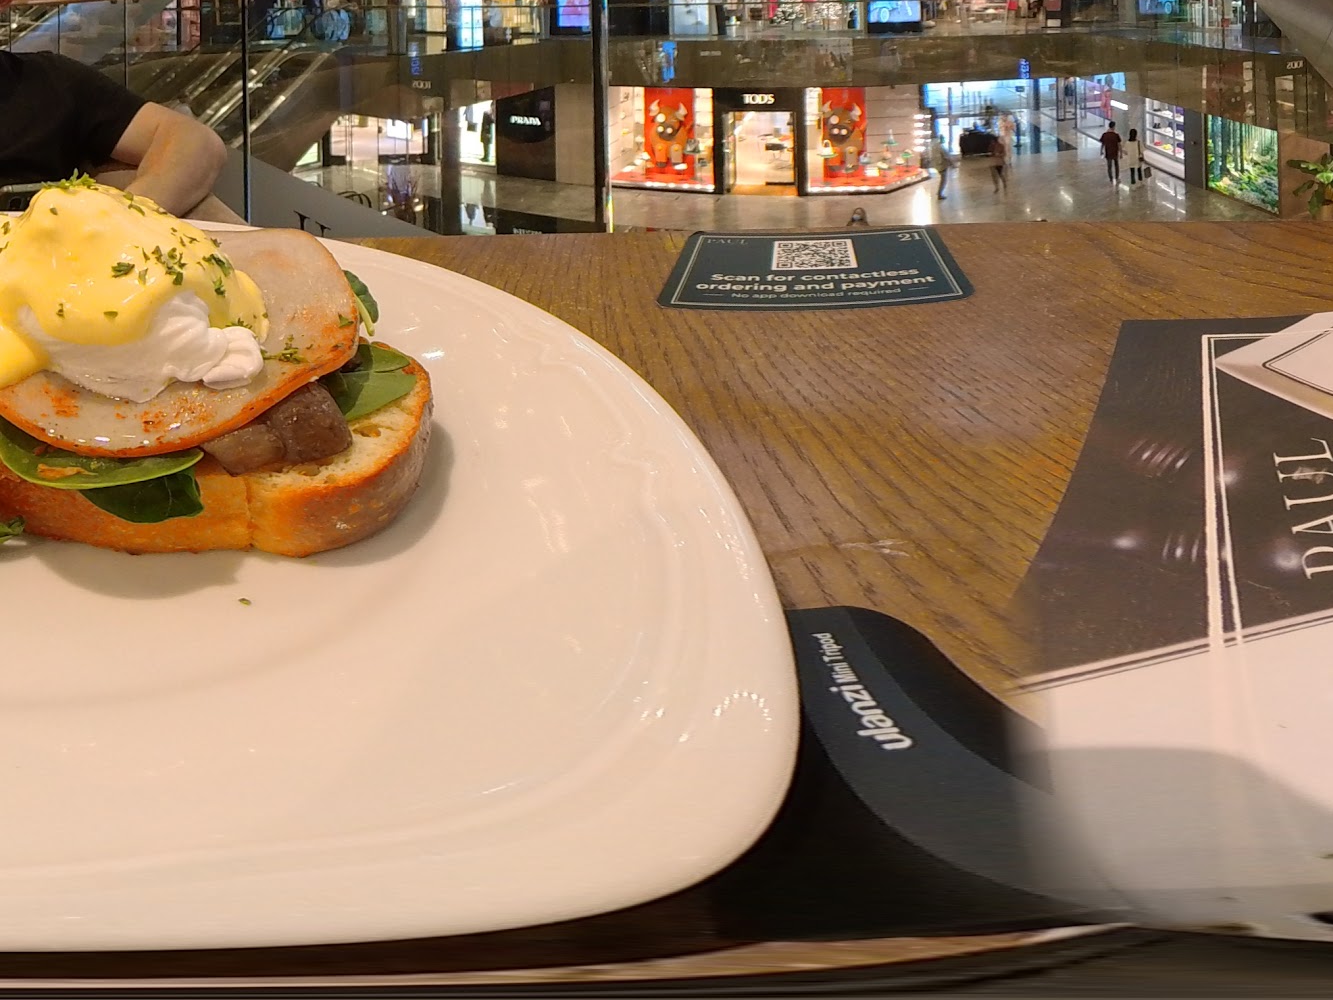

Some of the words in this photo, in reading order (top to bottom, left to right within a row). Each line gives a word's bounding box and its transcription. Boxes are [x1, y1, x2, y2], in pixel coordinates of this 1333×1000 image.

[510, 115, 541, 126] PRADA
[707, 238, 748, 246] PAUL
[897, 232, 921, 242] 21
[711, 273, 760, 281] Scan
[766, 274, 796, 282] for
[801, 268, 919, 281] contactless
[696, 282, 788, 292] ordering
[793, 282, 834, 290] and
[841, 275, 936, 290] payment
[847, 288, 901, 296] required
[811, 632, 845, 662] Tripod
[826, 662, 859, 683] Mini
[829, 684, 913, 750] ulanzi
